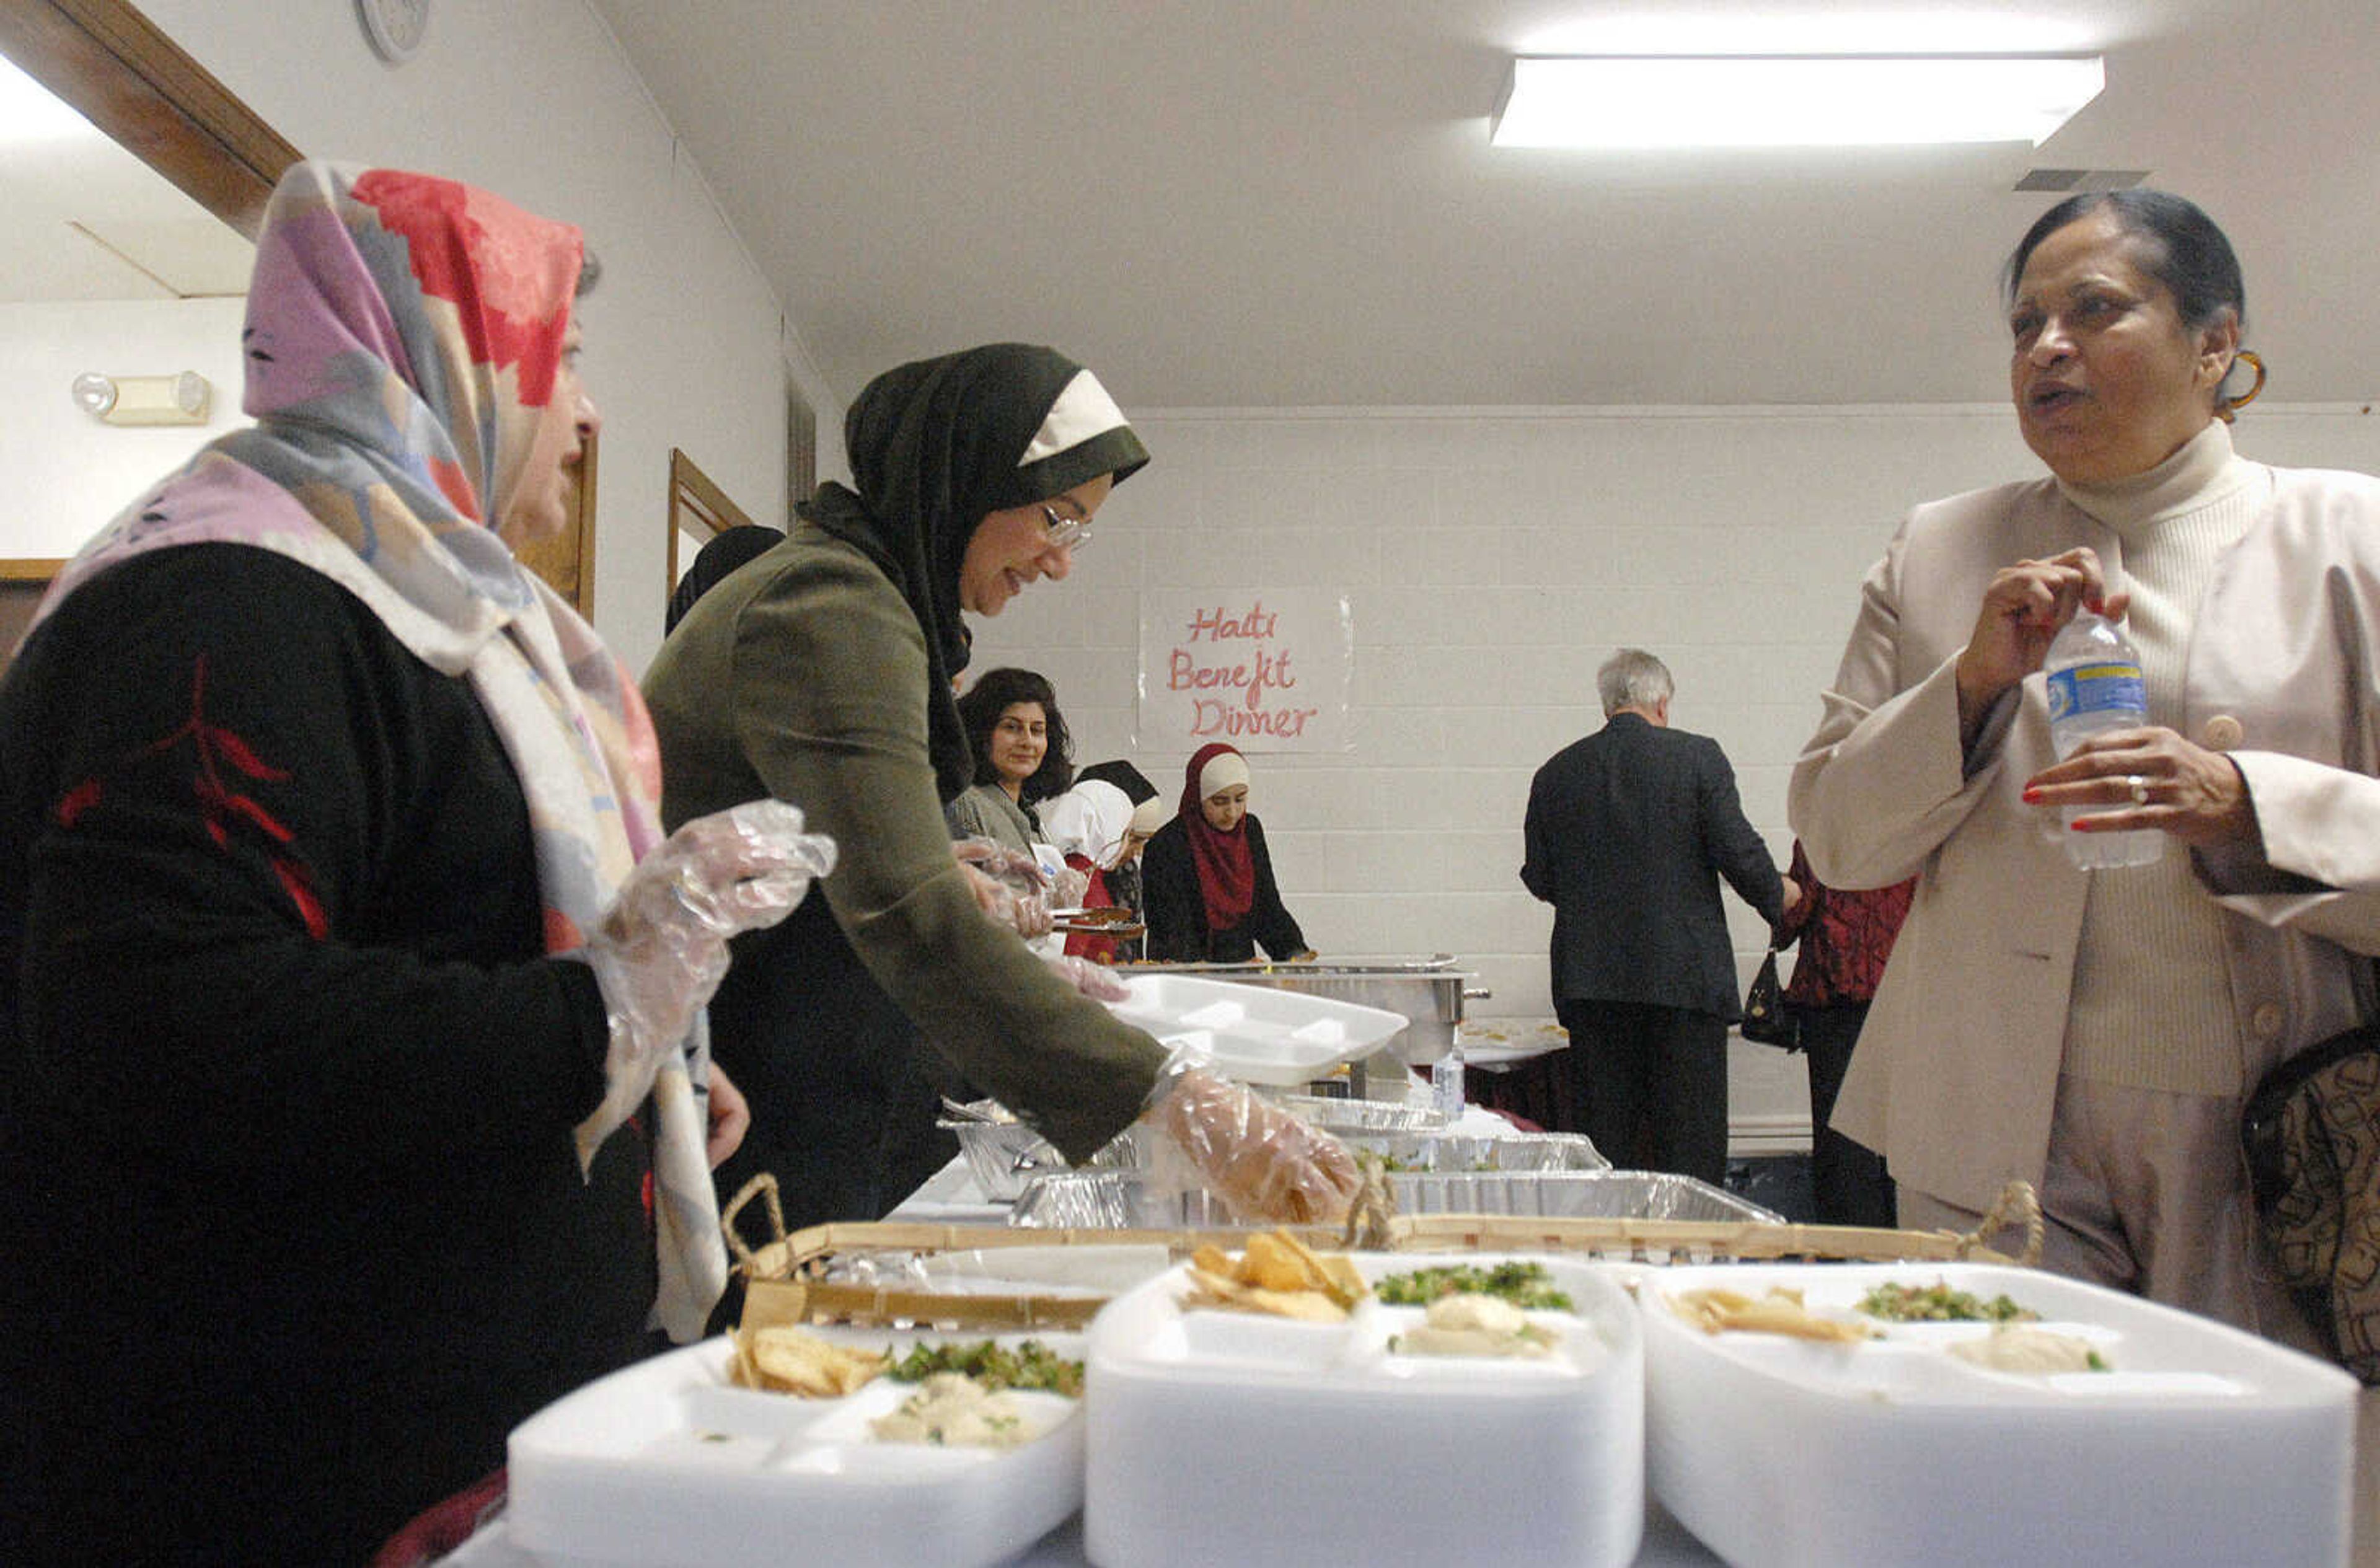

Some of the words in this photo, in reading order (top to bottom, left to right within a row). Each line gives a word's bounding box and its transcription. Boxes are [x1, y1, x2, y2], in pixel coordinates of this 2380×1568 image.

[1188, 601, 1278, 642] Haiti
[1167, 648, 1297, 711] Benefit
[1189, 698, 1318, 737] Dinner
